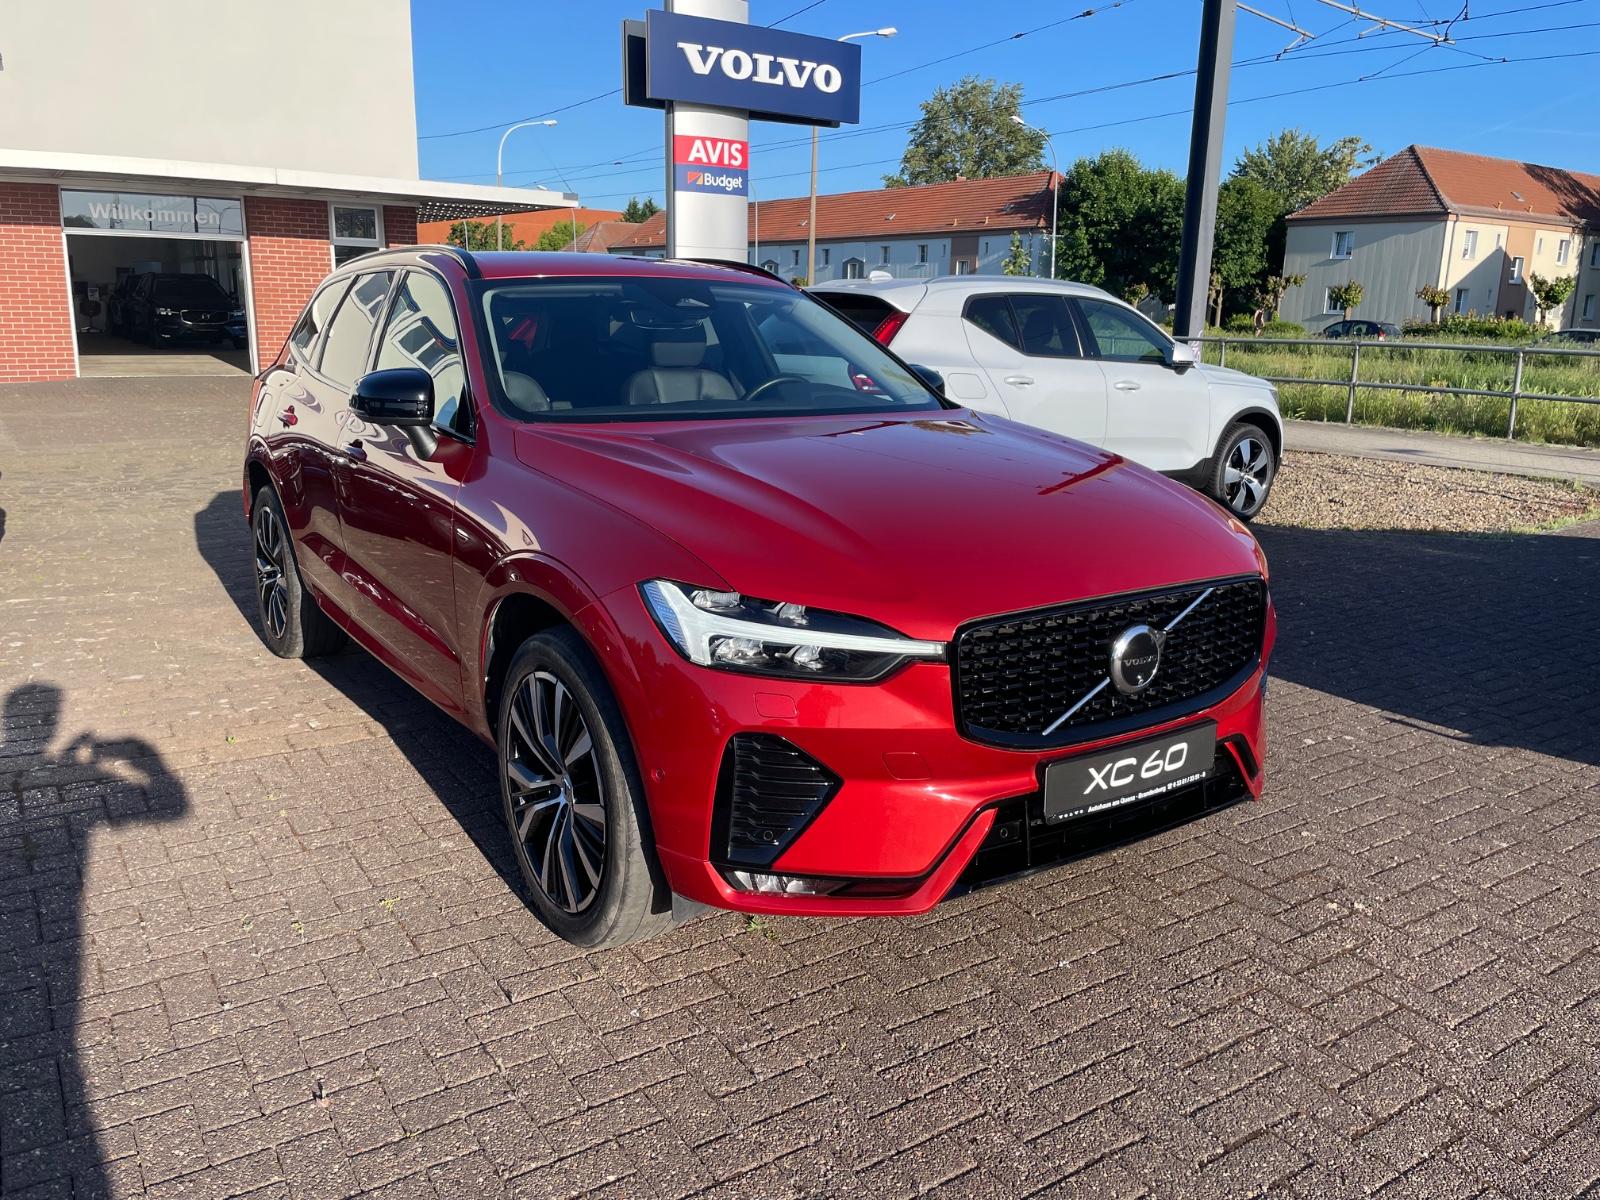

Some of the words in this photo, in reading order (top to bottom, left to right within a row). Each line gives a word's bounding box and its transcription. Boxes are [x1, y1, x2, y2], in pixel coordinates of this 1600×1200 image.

[677, 42, 842, 93] VOLVO
[688, 139, 742, 166] AVIS
[704, 172, 742, 191] Budget
[88, 202, 220, 225] Willkommen
